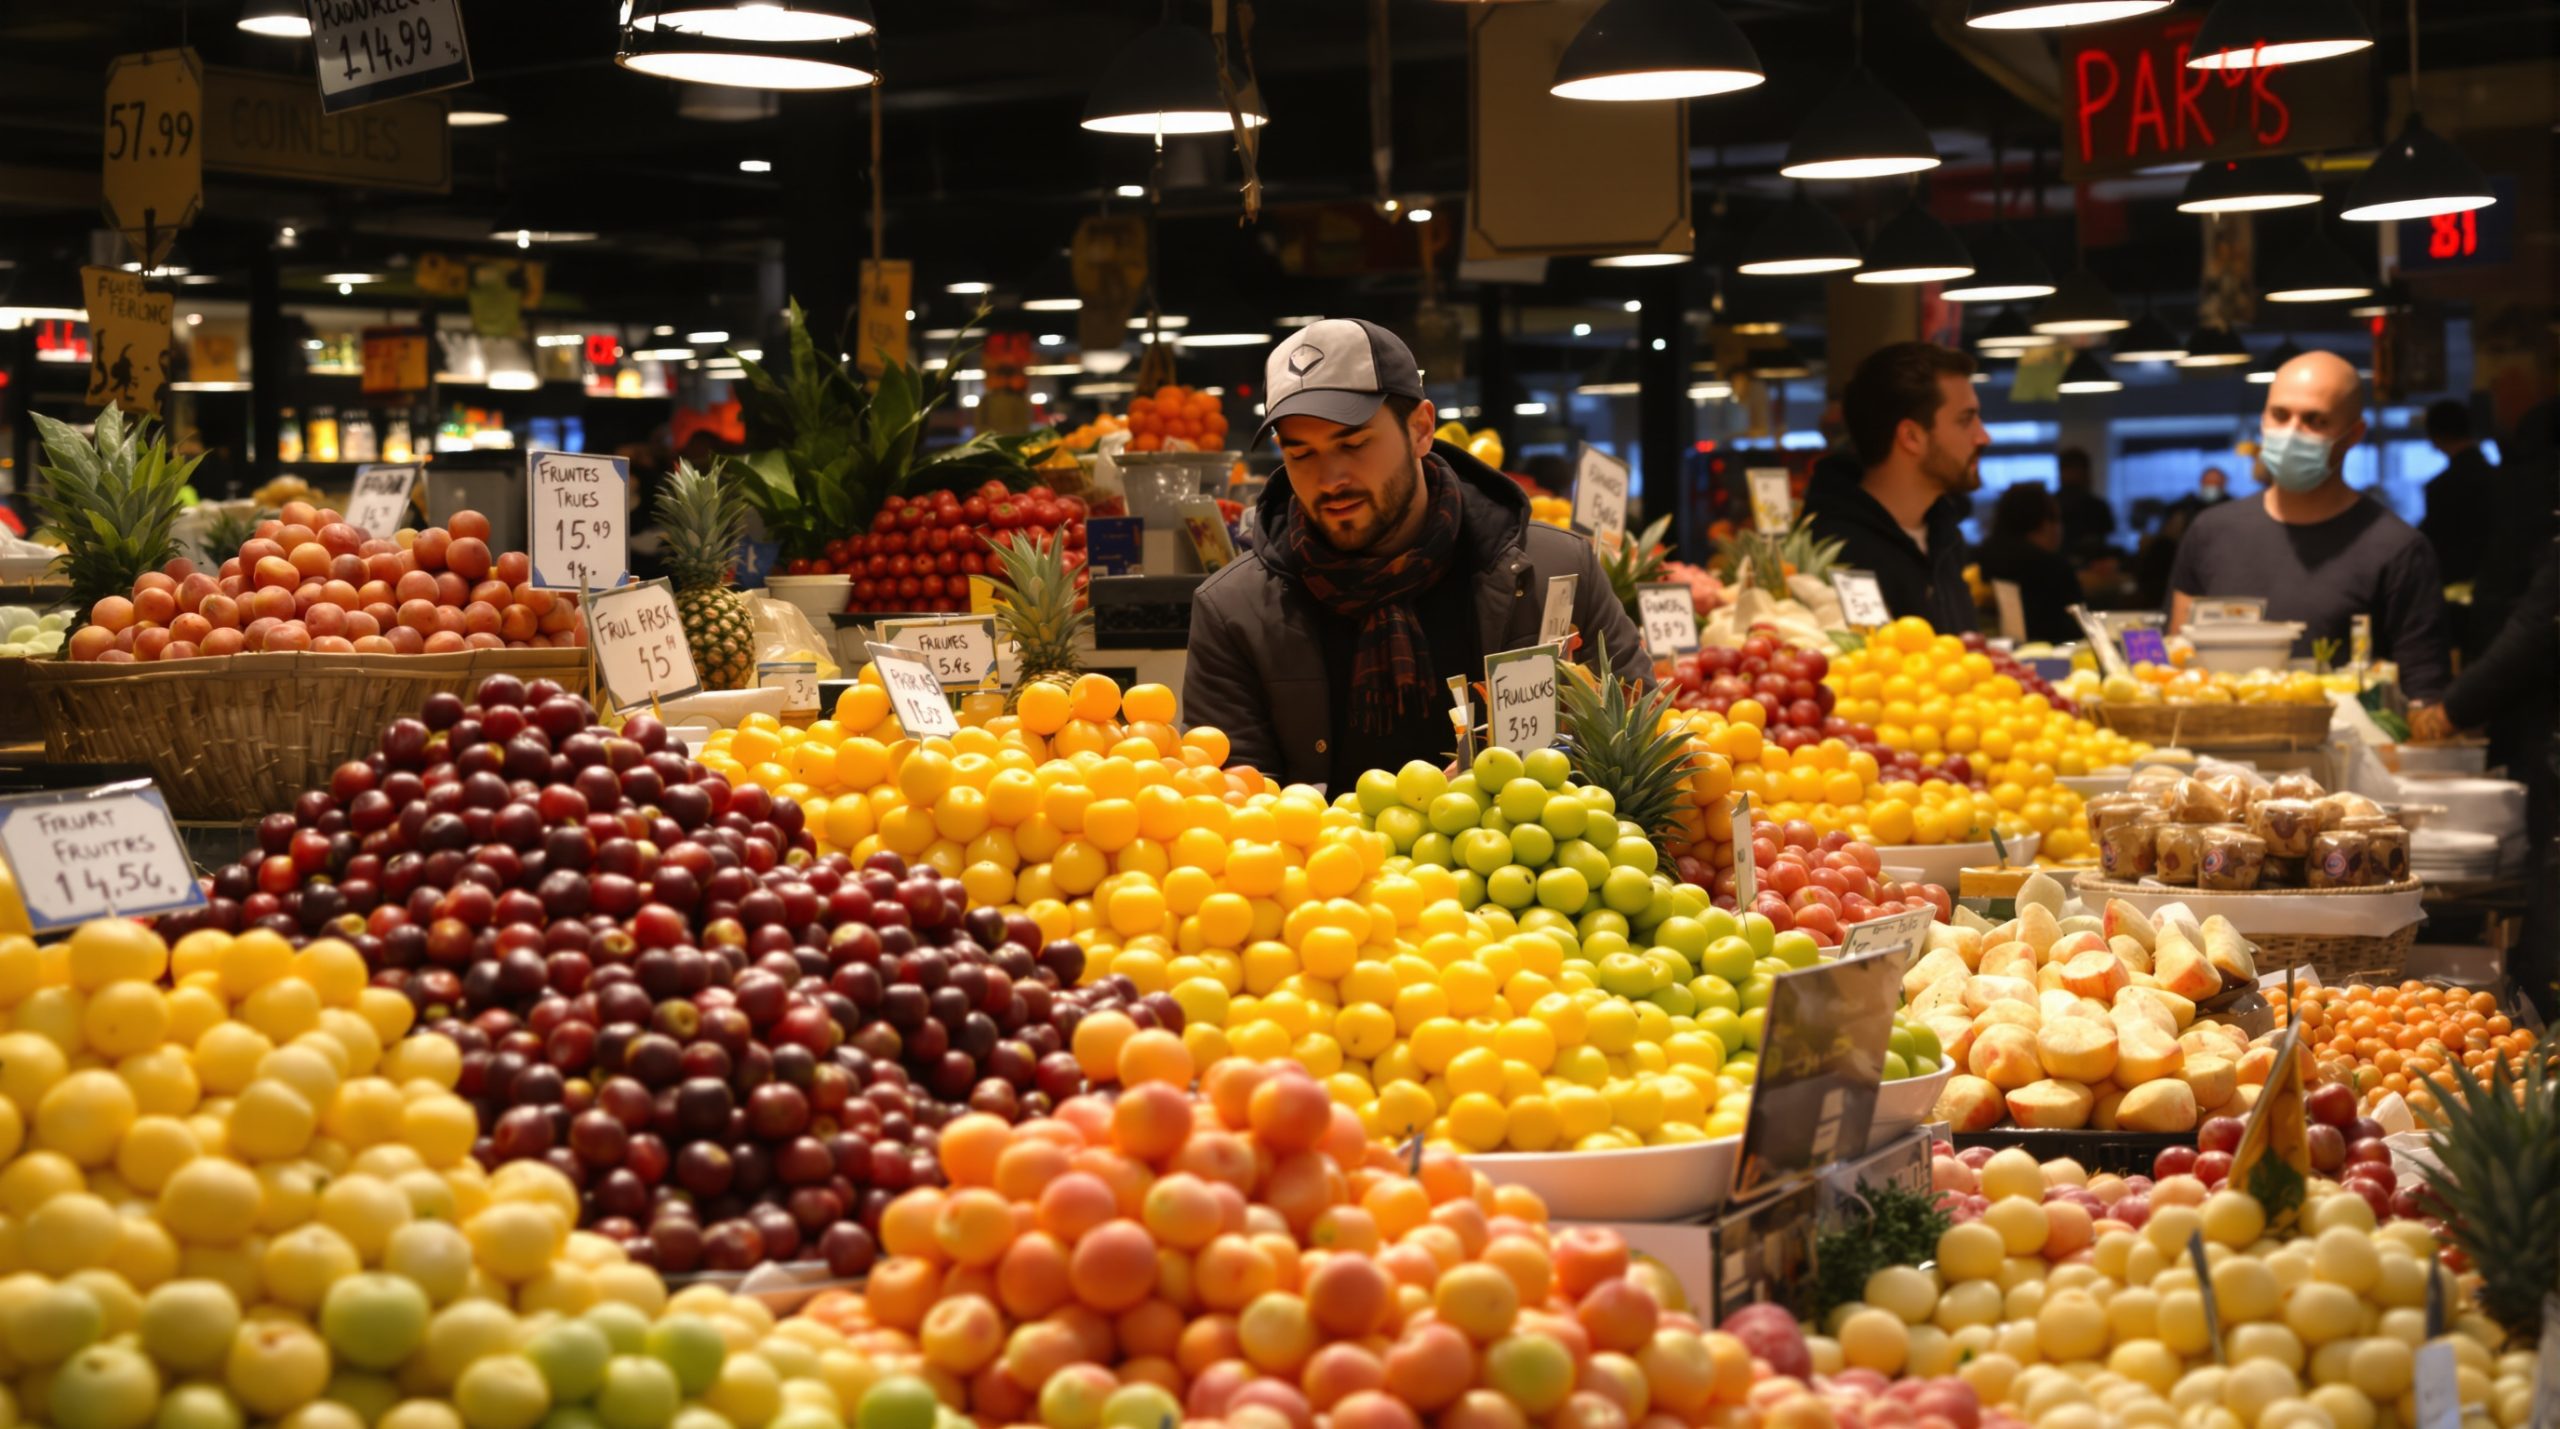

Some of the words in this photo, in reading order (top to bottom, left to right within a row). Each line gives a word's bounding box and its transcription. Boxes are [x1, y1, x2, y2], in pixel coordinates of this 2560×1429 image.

[339, 16, 432, 80] 114.99
[108, 101, 193, 162] 57.99
[1509, 715, 1539, 743] 359
